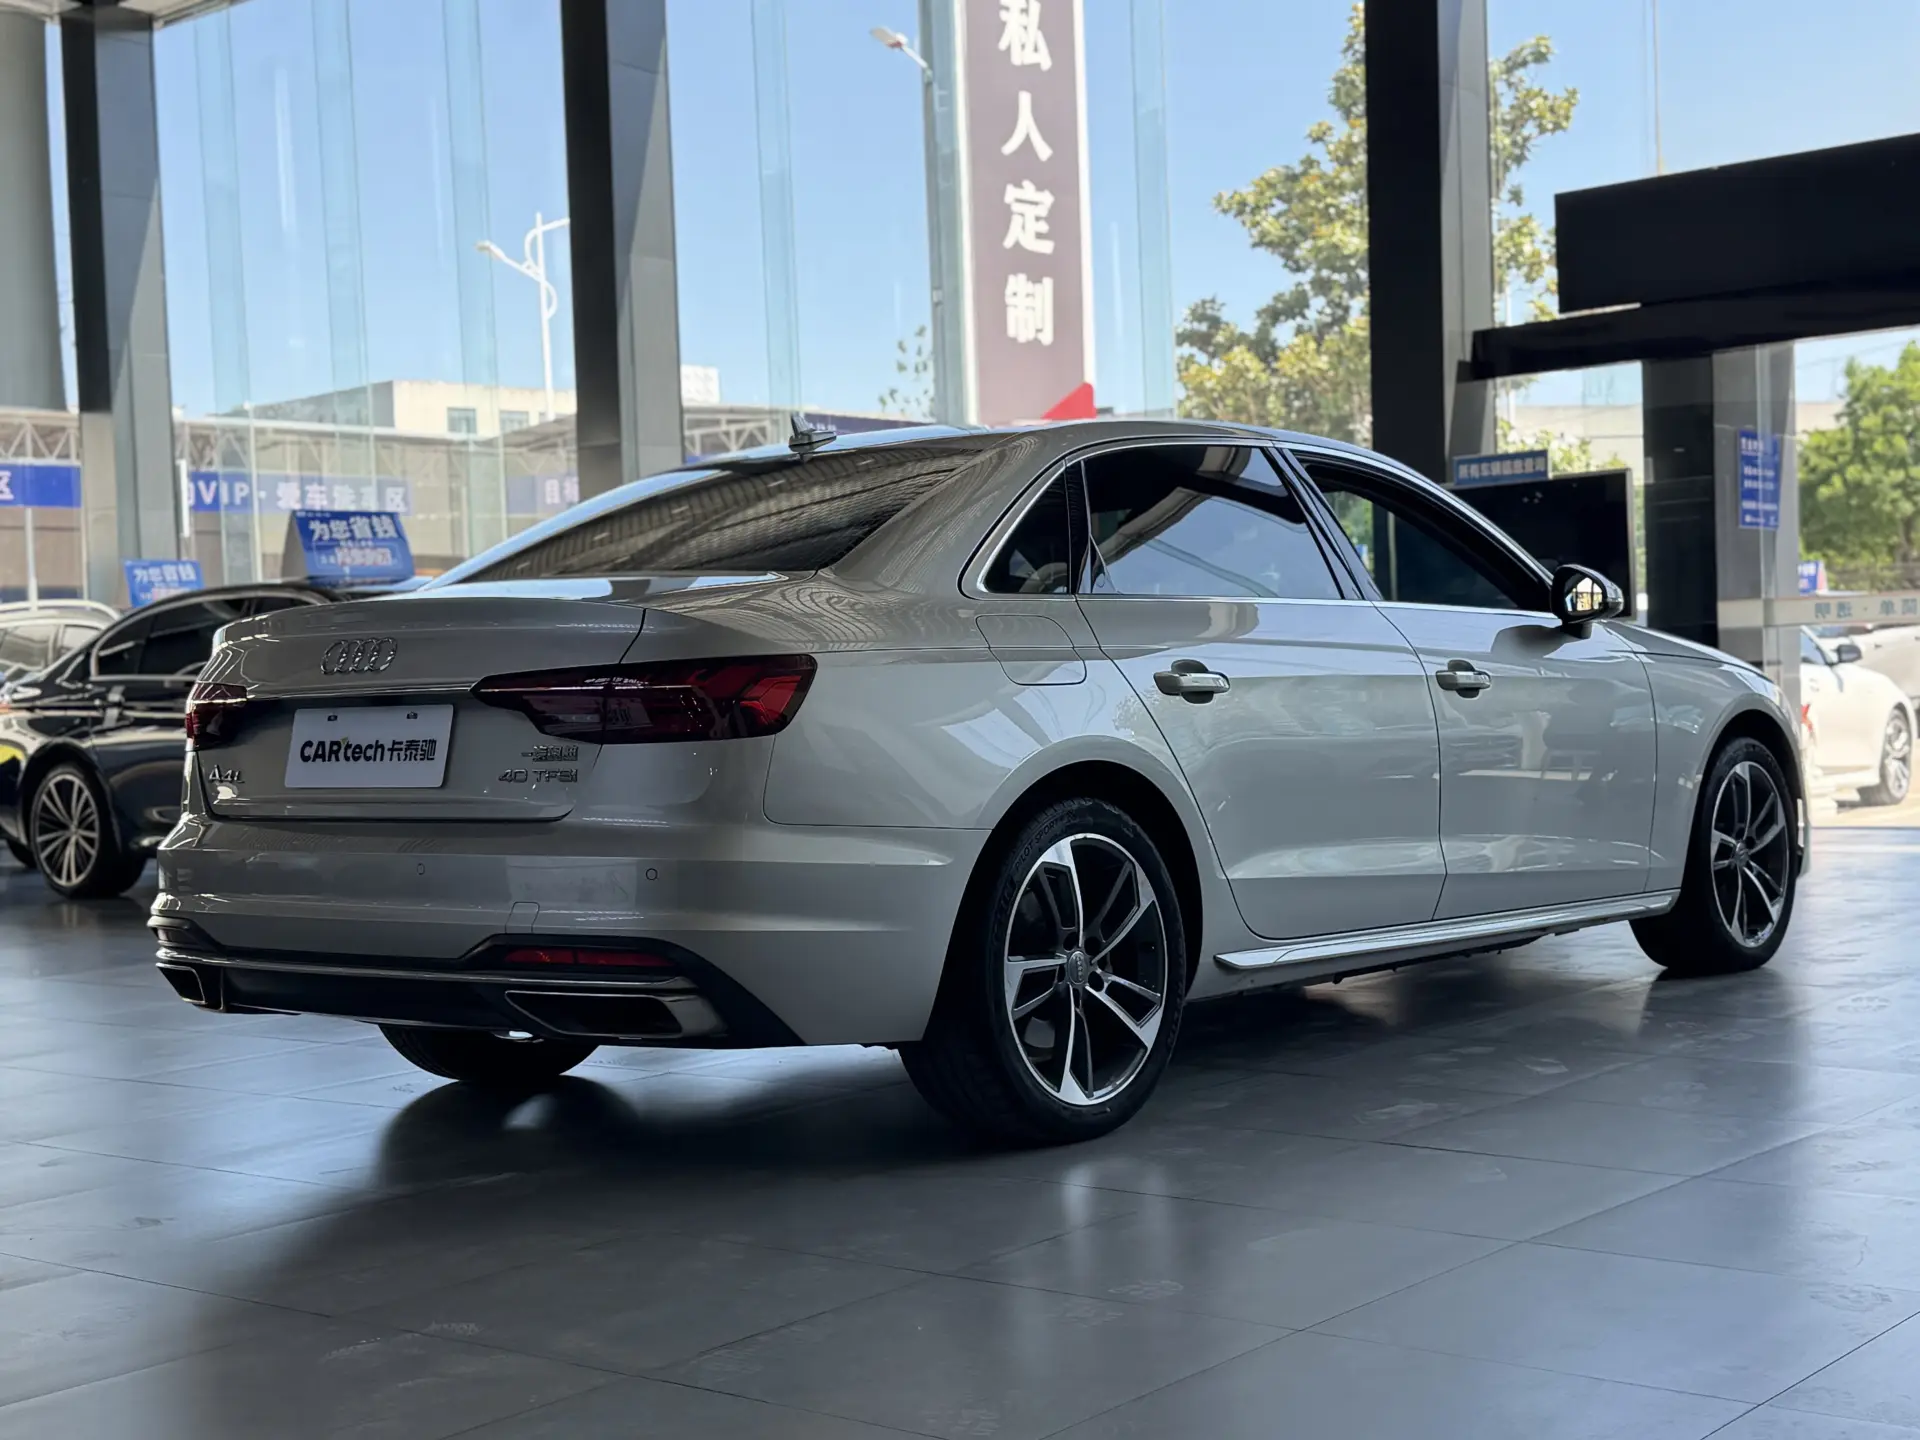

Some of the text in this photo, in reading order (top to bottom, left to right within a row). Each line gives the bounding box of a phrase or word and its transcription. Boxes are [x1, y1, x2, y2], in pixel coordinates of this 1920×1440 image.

[998, 0, 1055, 346] 私人定制
[387, 738, 437, 762] 卡泰驰
[499, 768, 578, 783] 40 TFSI
